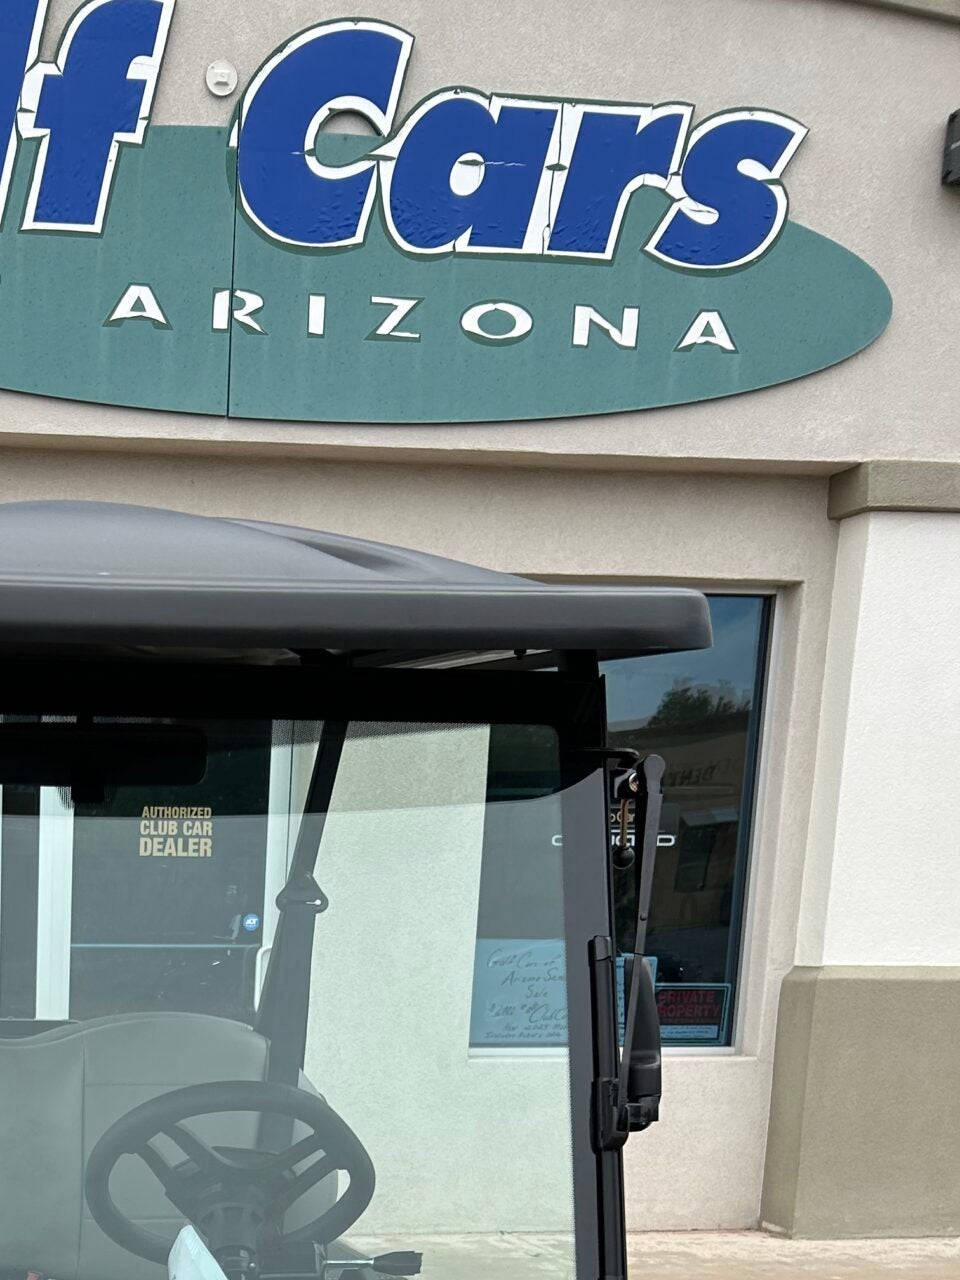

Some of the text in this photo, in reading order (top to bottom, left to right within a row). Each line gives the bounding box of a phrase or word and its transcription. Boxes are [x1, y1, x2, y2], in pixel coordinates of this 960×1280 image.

[232, 18, 809, 270] Cars
[110, 284, 737, 352] ARIZONA
[142, 806, 212, 819] AUTHORIZED
[140, 820, 213, 837] CLUB CAR
[140, 837, 212, 857] DEALER
[659, 991, 715, 1003] PRIVATE
[658, 1004, 721, 1017] ROPERTY
